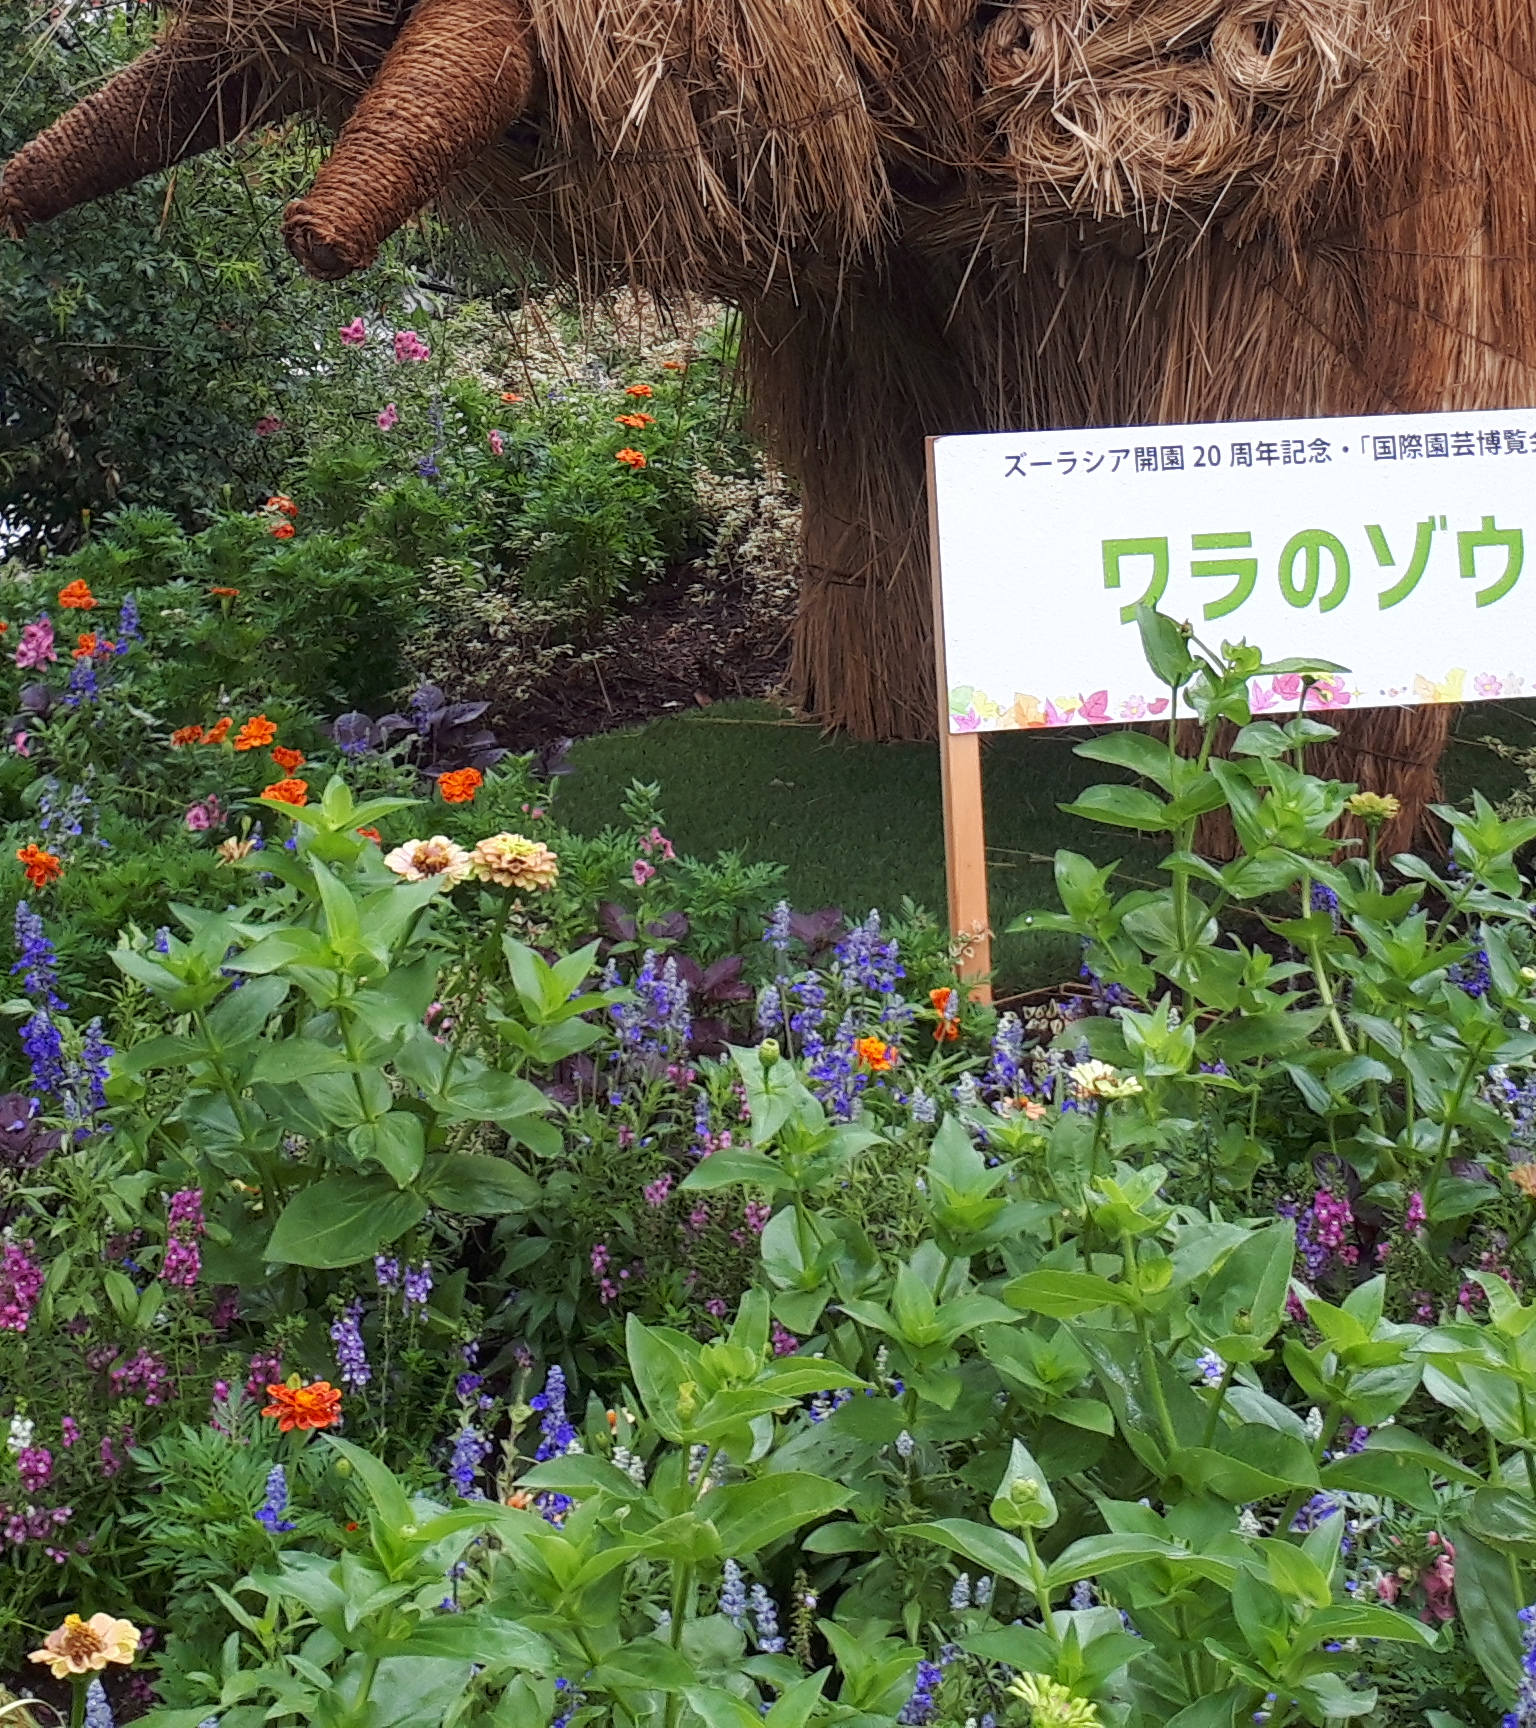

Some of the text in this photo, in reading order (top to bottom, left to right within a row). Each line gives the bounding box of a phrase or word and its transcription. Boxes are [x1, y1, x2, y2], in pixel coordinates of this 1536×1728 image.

[1004, 444, 1185, 478] ズーラシア開園
[1192, 445, 1222, 469] 20
[1101, 513, 1525, 626] ワラのゾウ
